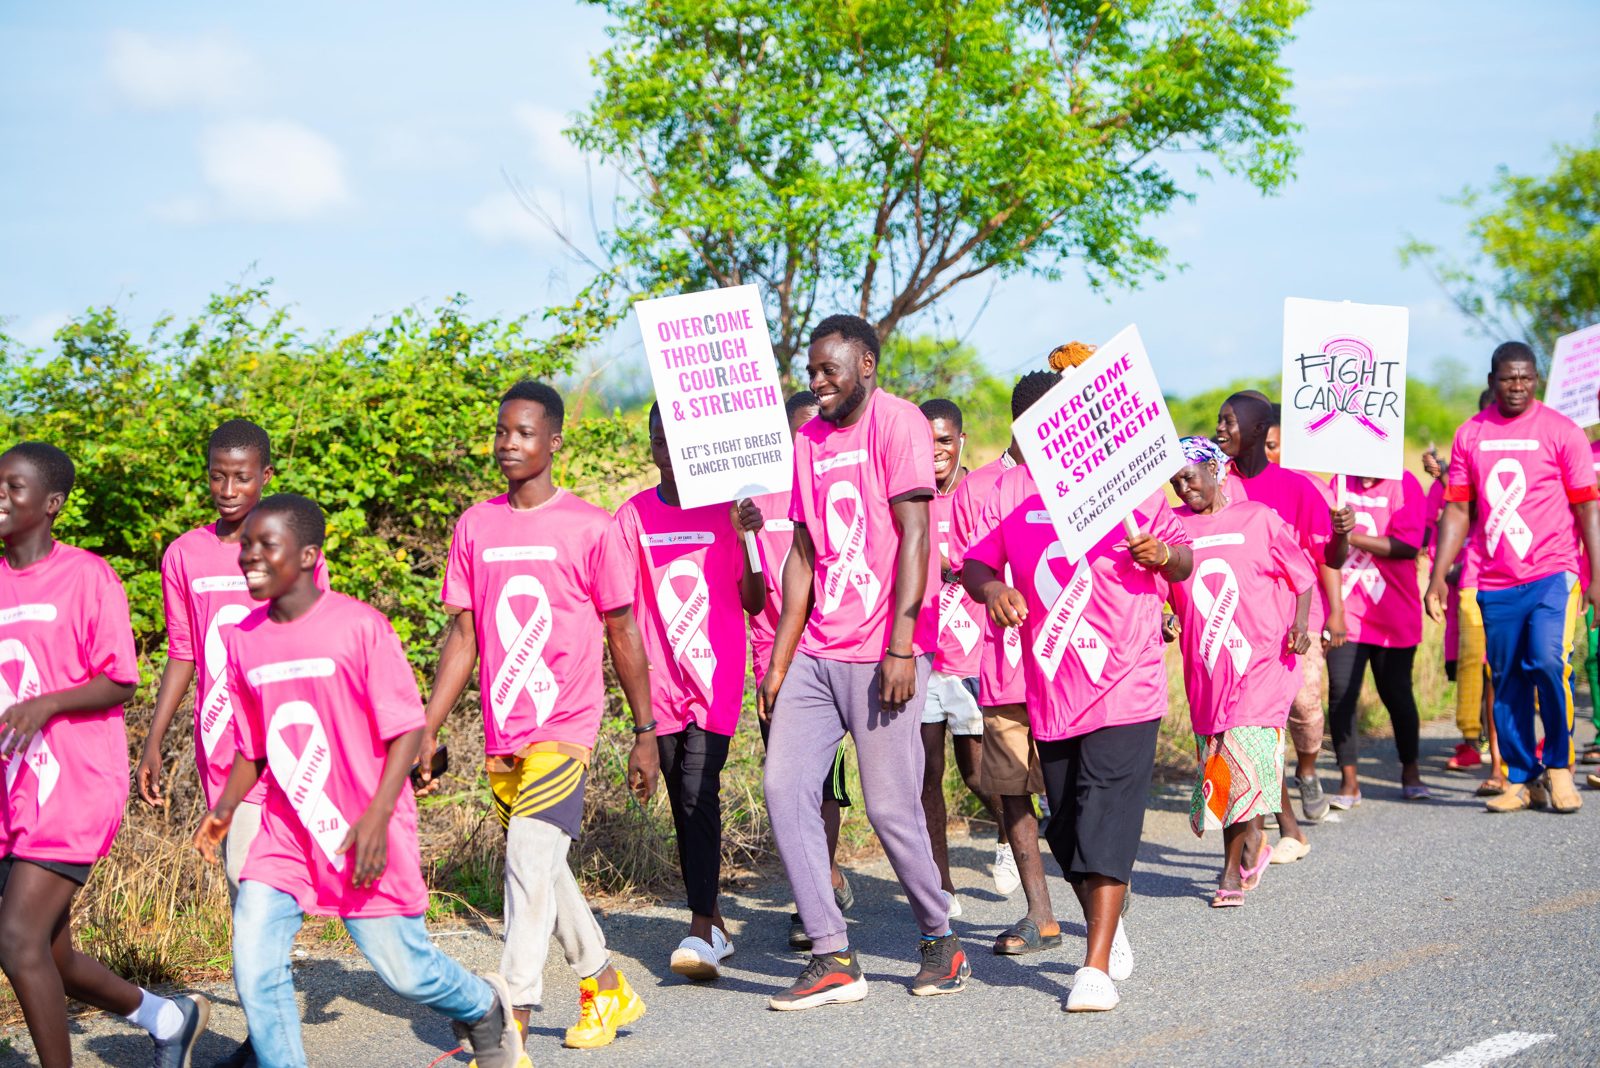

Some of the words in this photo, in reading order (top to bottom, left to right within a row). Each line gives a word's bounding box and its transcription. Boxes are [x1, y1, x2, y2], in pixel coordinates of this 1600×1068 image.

[657, 309, 753, 342] OVERCOME
[660, 337, 748, 369] THROUGH
[1295, 353, 1400, 388] FIGHT
[678, 361, 762, 393] COURAGE
[1037, 352, 1134, 441] OVERCOME
[672, 401, 686, 421] &
[689, 385, 778, 418] STRENGTH
[1041, 382, 1129, 460] THROUGH
[1294, 384, 1400, 418] CANCER
[712, 438, 742, 455] FIGHT
[744, 431, 783, 450] BREAST
[1055, 481, 1070, 498] &
[1072, 401, 1161, 483] STRENGTH
[1060, 391, 1145, 469] COURAGE
[689, 457, 730, 476] CANCER
[733, 449, 783, 468] TOGETHER
[1097, 468, 1127, 498] FIGHT
[1128, 434, 1166, 472] BREAST
[1075, 494, 1116, 532] CANCER
[1116, 449, 1168, 496] TOGETHER
[851, 514, 864, 547] PINK
[846, 547, 857, 562] IN
[675, 620, 689, 636] IN
[685, 592, 708, 621] PINK
[1041, 624, 1064, 659] WALK
[1056, 608, 1072, 625] IN
[1066, 575, 1090, 609] PINK
[1203, 629, 1218, 661] WALK
[1212, 615, 1223, 629] IN
[1218, 587, 1236, 615] PINK
[495, 665, 520, 706] WALK
[515, 647, 530, 666] IN
[524, 615, 548, 650] PINK
[1077, 637, 1098, 649] 3.0
[203, 693, 228, 733] WALK
[293, 785, 309, 804] IN
[302, 744, 327, 784] PINK
